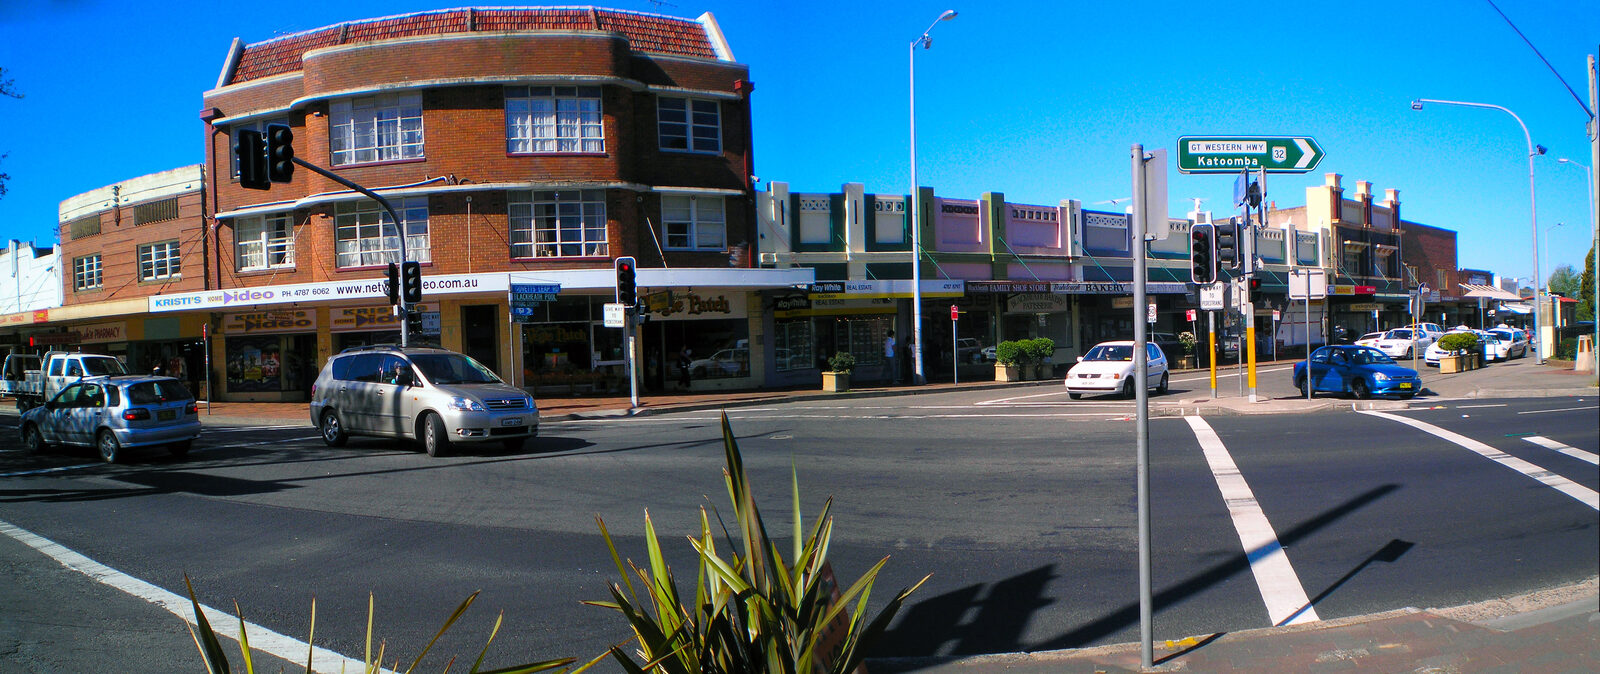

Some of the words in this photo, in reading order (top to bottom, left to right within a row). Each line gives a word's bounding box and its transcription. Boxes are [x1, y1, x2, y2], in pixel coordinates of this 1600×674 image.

[1274, 149, 1285, 158] 32
[1197, 156, 1258, 166] Katoomba
[811, 284, 824, 292] Ray
[990, 283, 1011, 292] FAMILY
[1012, 283, 1028, 292] SHOE
[1029, 283, 1047, 292] STORE
[1085, 283, 1126, 292] BAKERY
[155, 296, 202, 307] KRISTI'S
[312, 287, 330, 295] 6062
[688, 295, 731, 315] Patch
